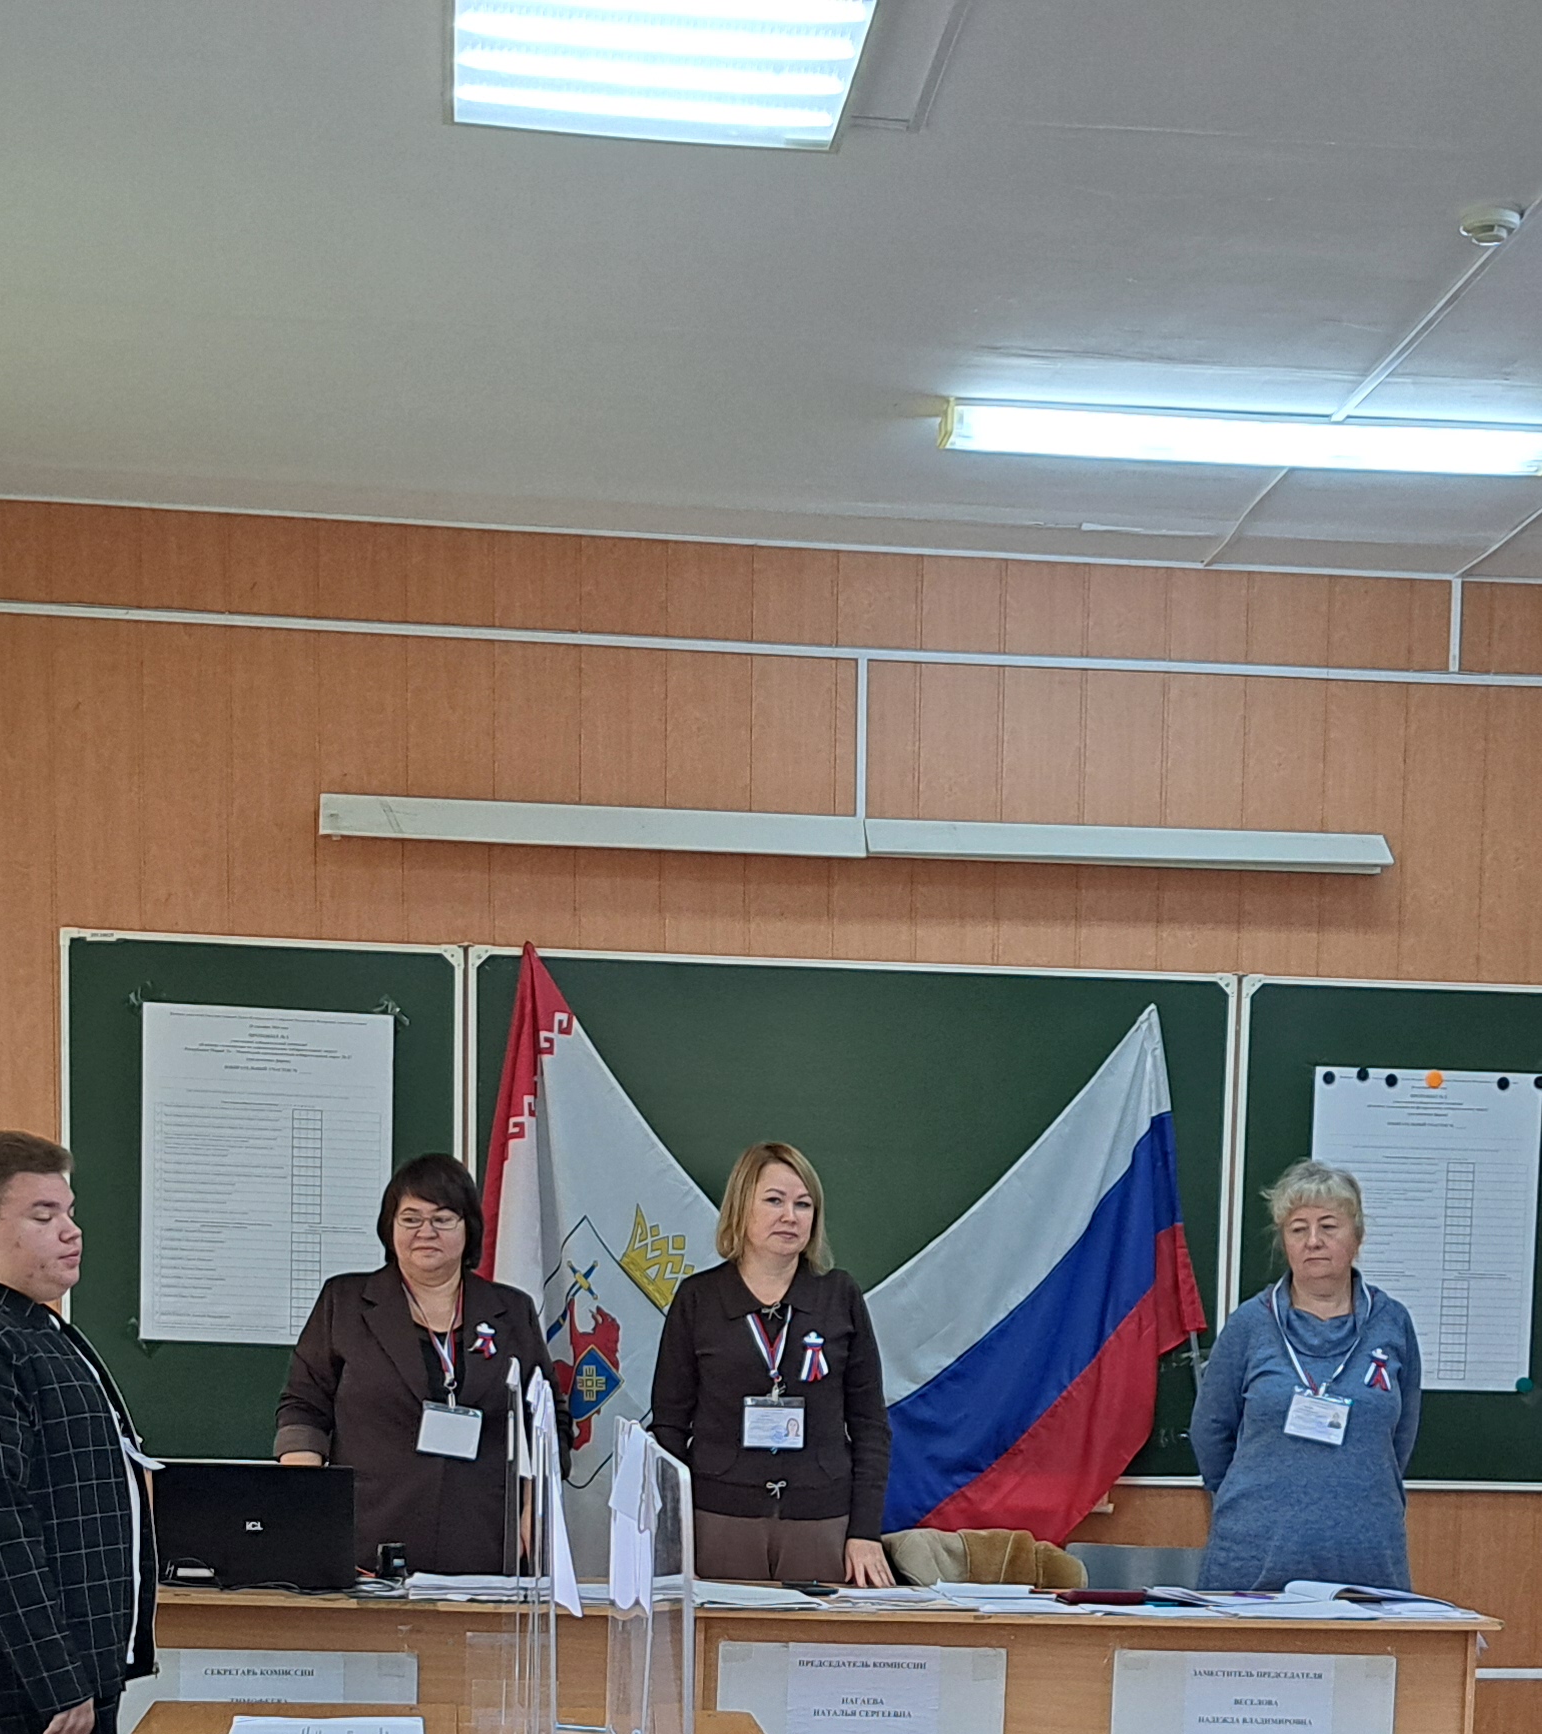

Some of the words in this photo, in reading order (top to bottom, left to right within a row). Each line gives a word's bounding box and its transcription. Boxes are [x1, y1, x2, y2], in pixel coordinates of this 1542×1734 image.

[798, 1659, 871, 1669] ПРЕДСЕДАТЕЛЬ
[872, 1660, 927, 1671] КОМИССИИ
[204, 1668, 258, 1677] СЕКРЕТАРЬ
[259, 1668, 315, 1677] КОМИССИИ
[1192, 1669, 1255, 1679] ЗАМЕСТИТЕЛЬ
[1256, 1670, 1324, 1680] ПРЕДСЕДАТЕЛЯ
[813, 1708, 857, 1718] НАТАЛЬЯ
[1198, 1716, 1241, 1725] НАДЕЖДА
